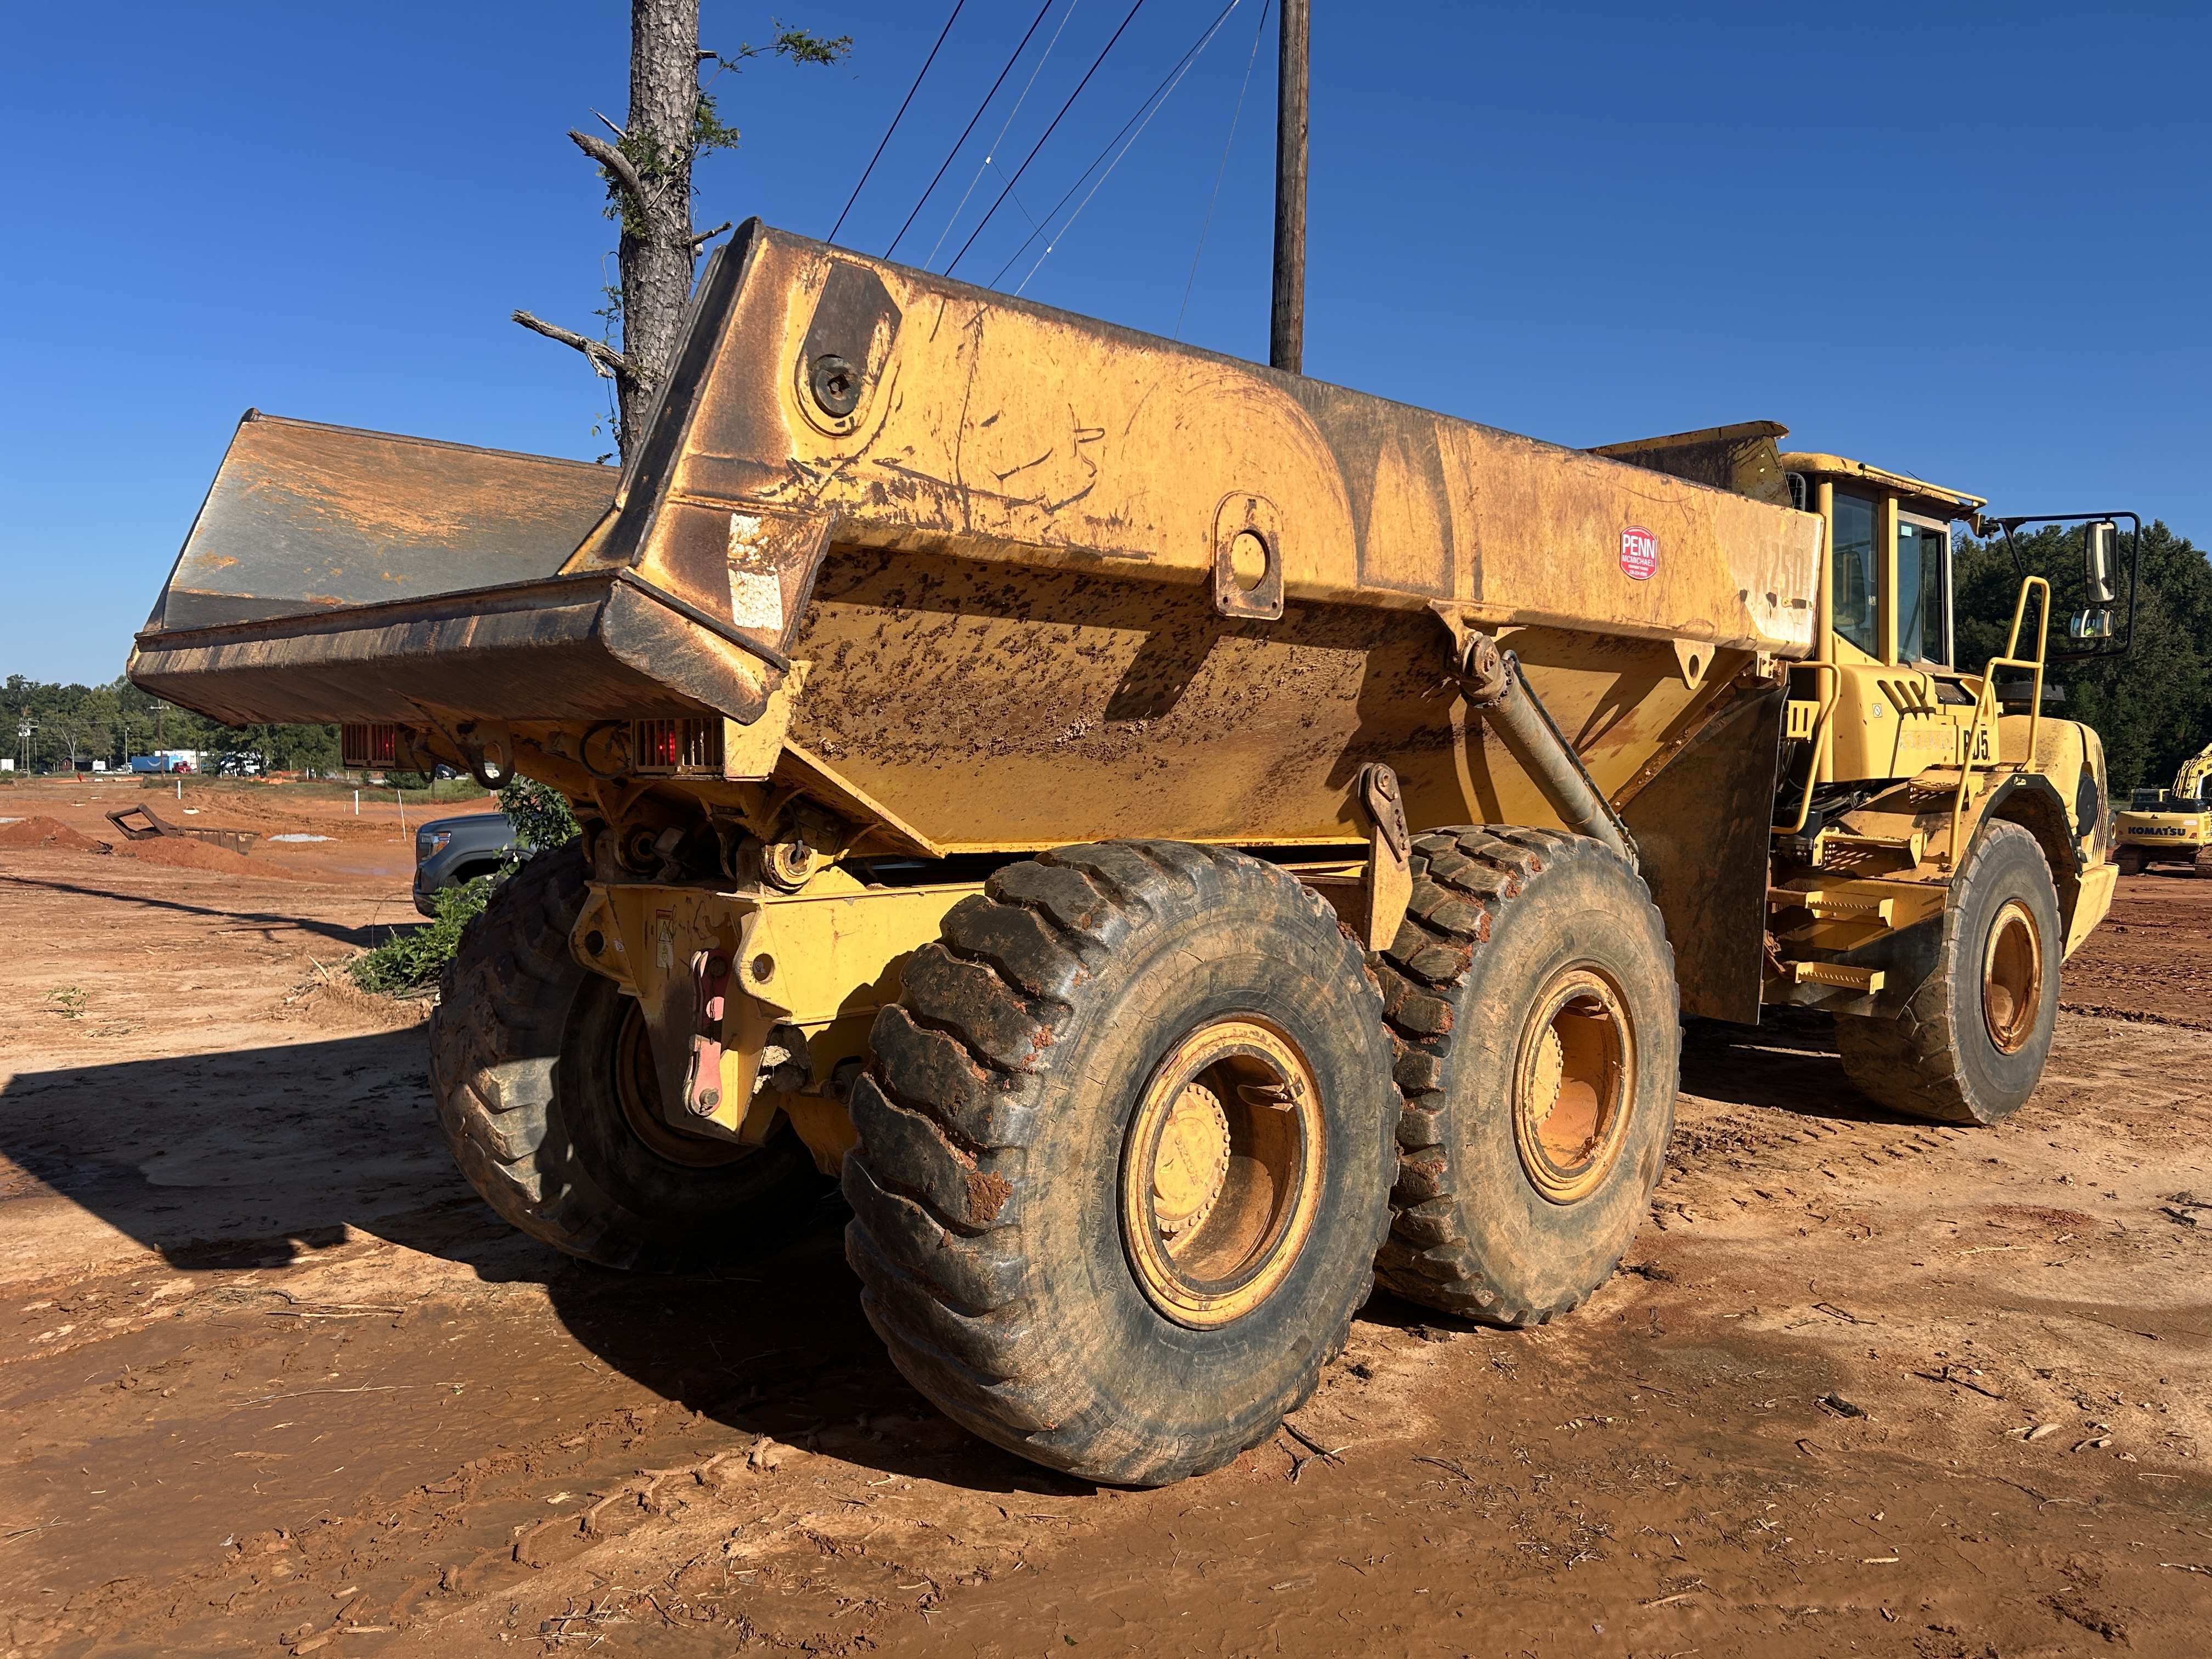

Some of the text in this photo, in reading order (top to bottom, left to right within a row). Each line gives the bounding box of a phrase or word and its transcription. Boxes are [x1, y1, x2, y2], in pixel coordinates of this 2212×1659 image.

[1623, 534, 1655, 558] PENN
[1622, 555, 1655, 567] MCMICHAEL
[2128, 826, 2186, 836] KOMATSU
